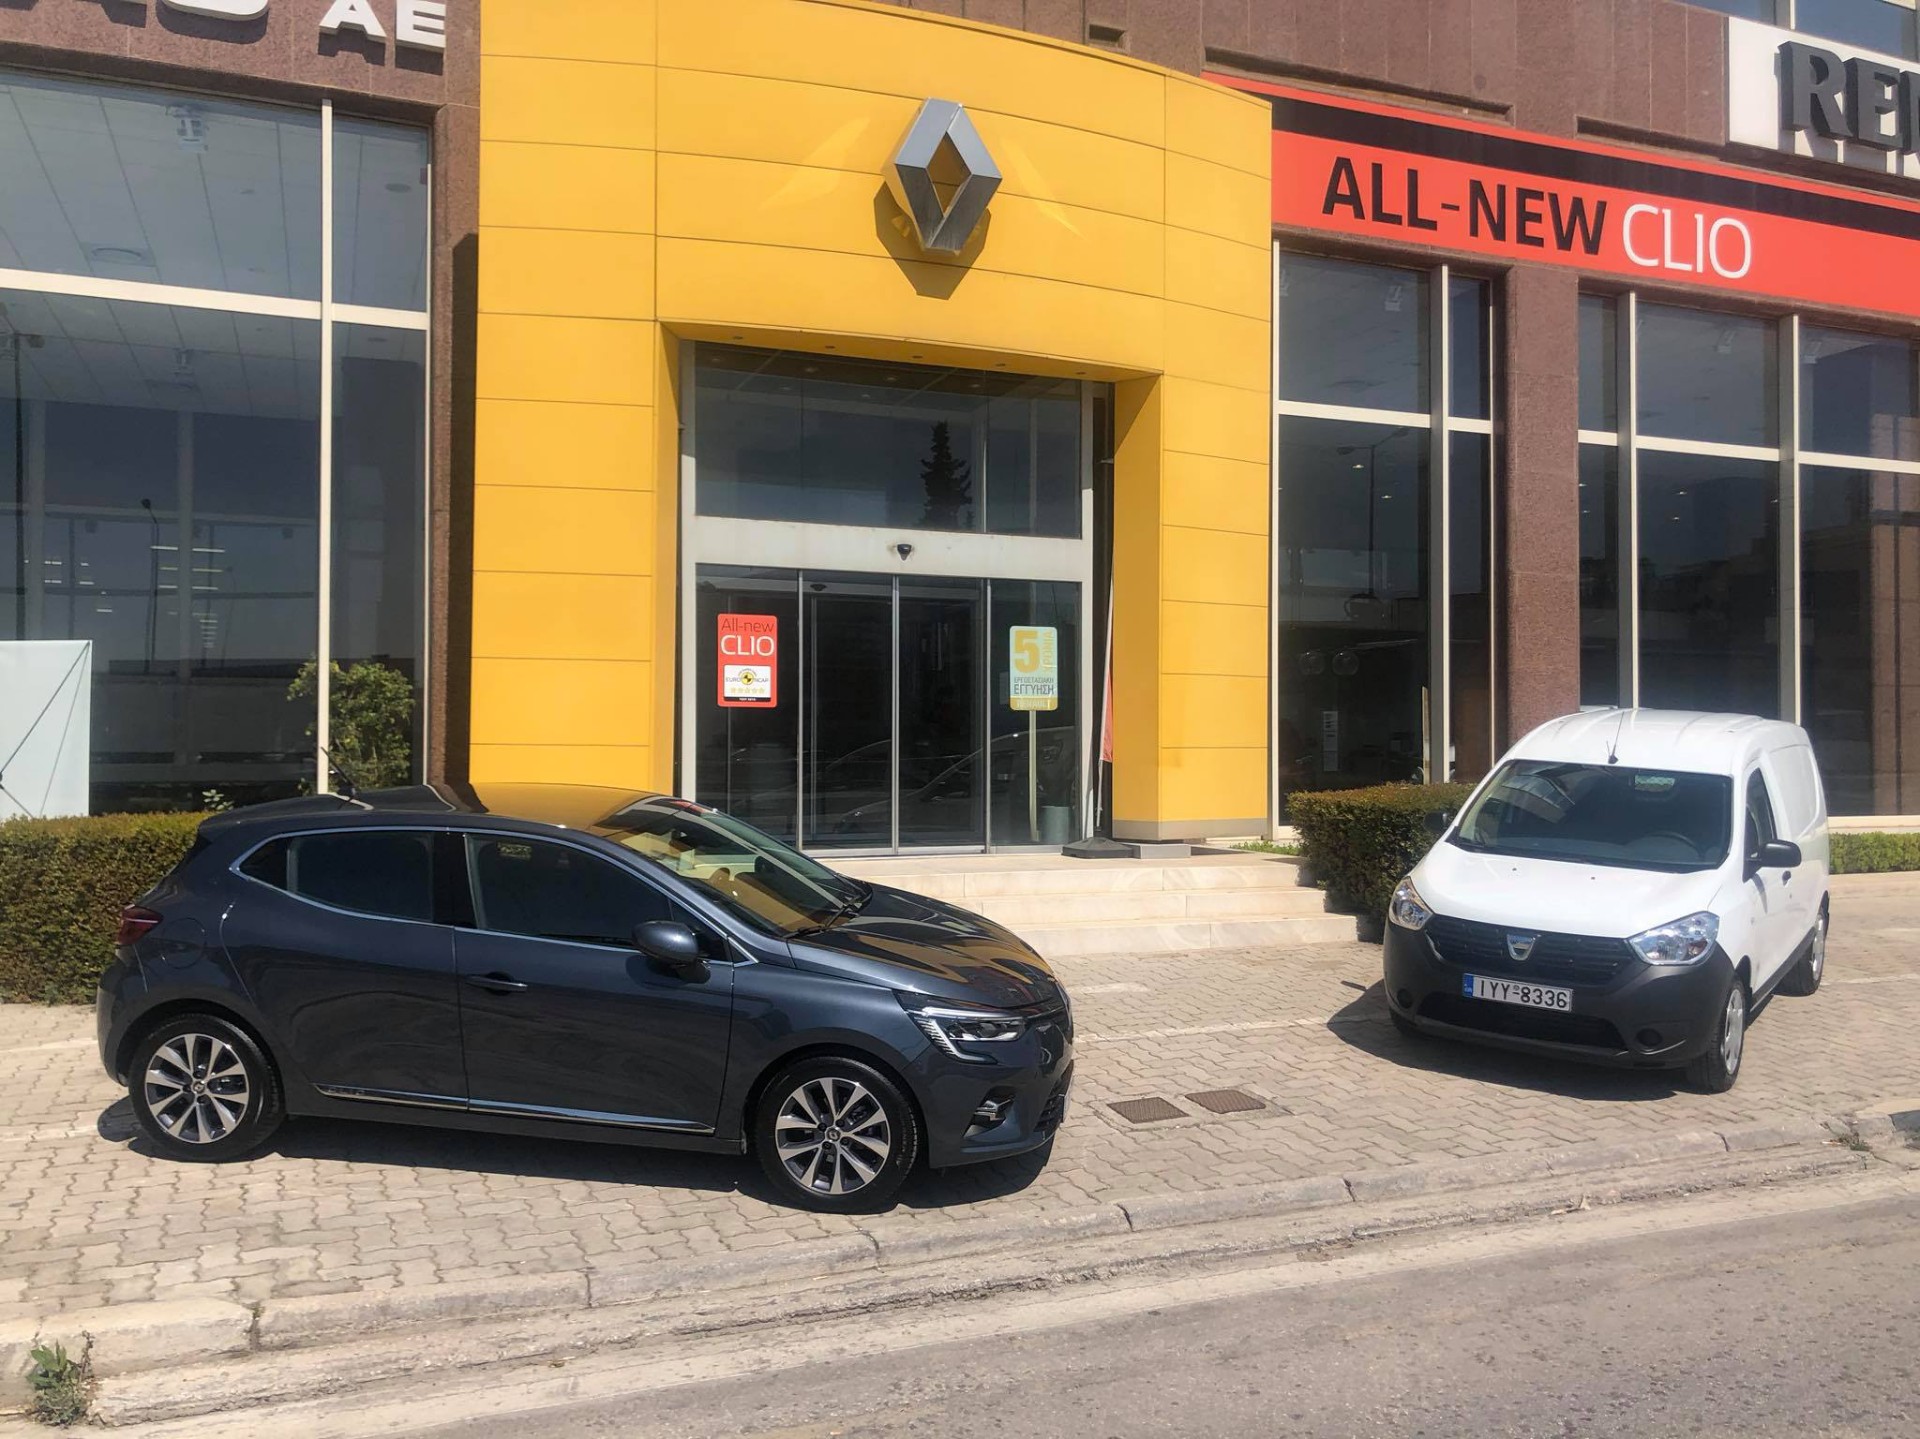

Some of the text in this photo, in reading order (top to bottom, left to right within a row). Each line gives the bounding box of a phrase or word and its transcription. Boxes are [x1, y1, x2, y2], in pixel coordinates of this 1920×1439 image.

[1322, 156, 1752, 279] ALL-NEW CLIO
[721, 618, 774, 632] All-new
[720, 634, 775, 656] CLIO
[1014, 630, 1040, 673] 5
[1013, 684, 1054, 695] ΕΓΓΥΗΣΗ
